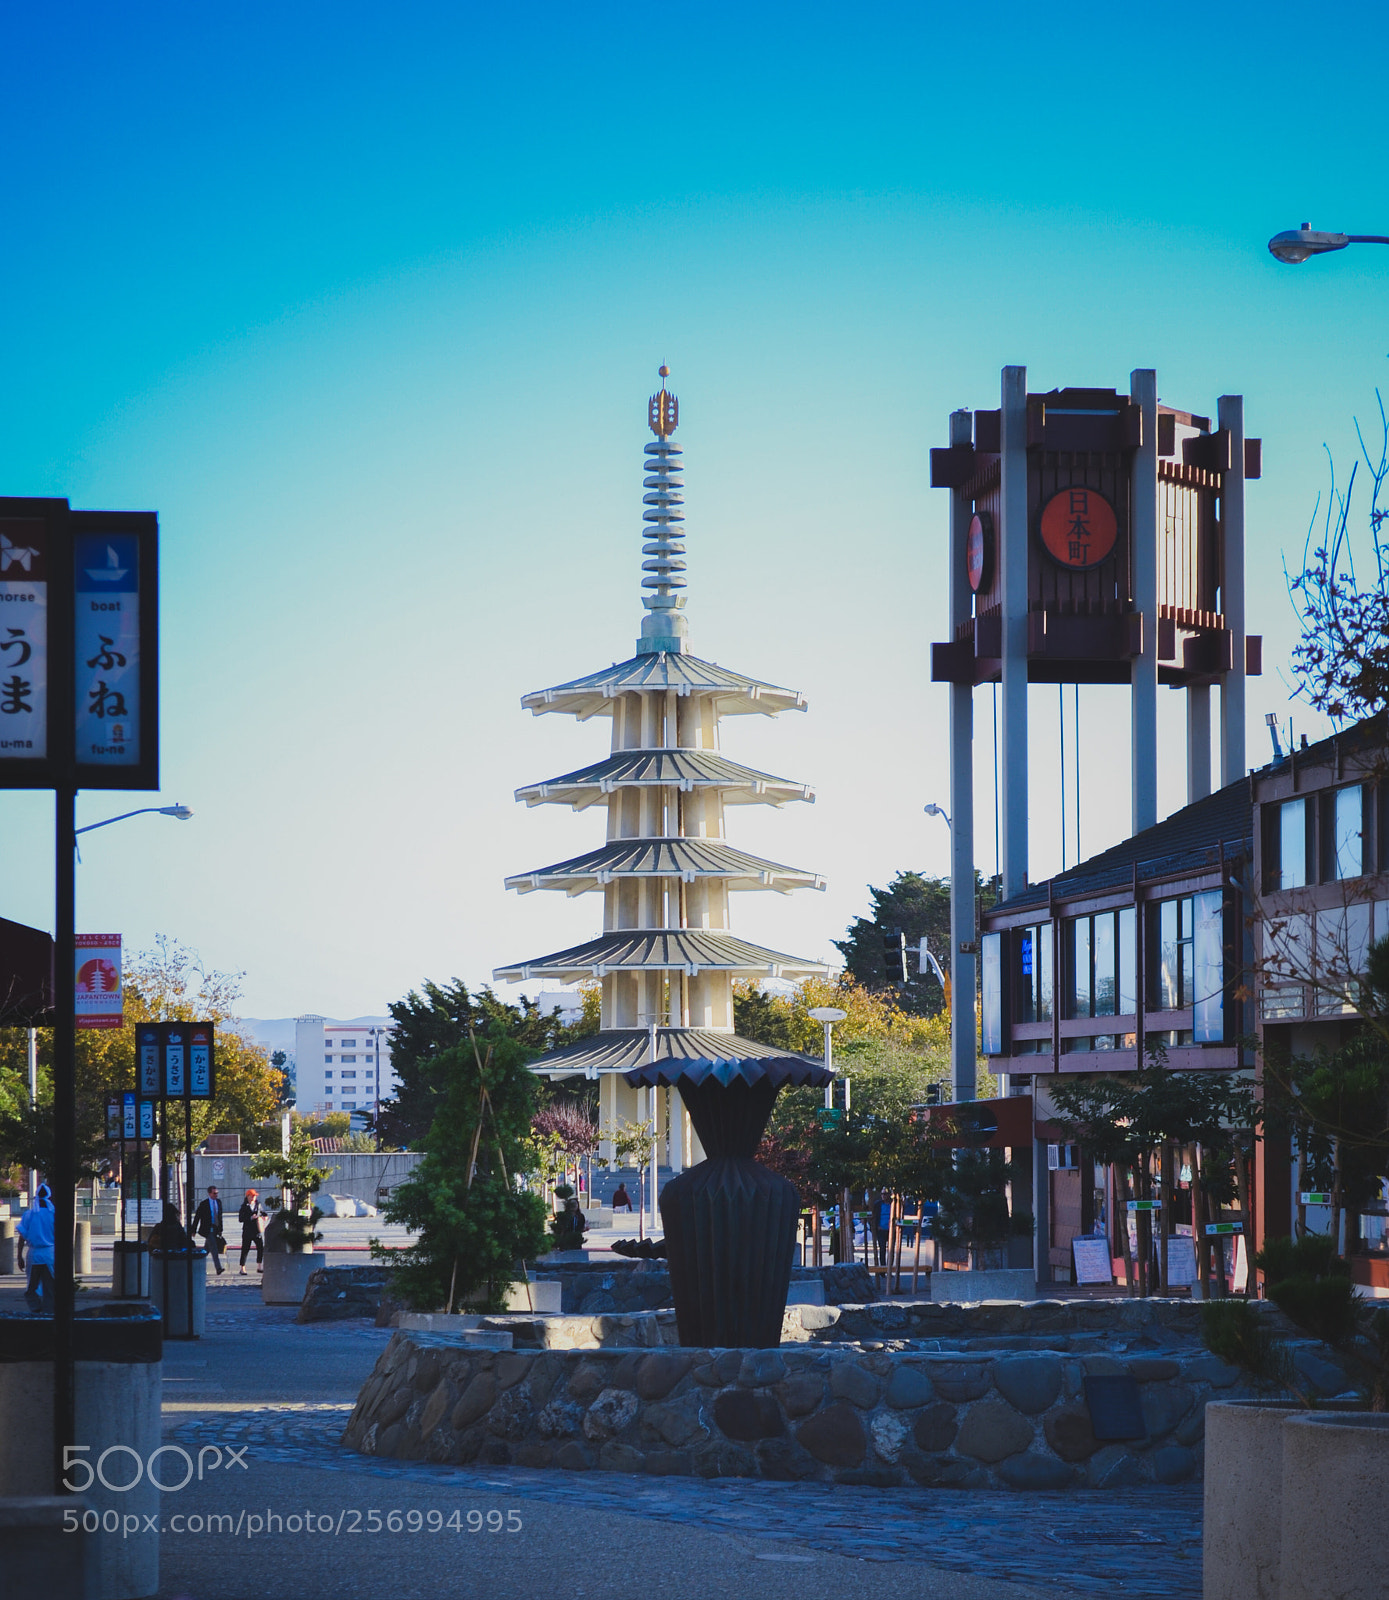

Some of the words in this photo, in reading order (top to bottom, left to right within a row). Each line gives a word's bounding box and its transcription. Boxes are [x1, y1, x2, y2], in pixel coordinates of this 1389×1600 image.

[1066, 491, 1091, 564] 日本町
[90, 600, 121, 611] boat
[0, 627, 33, 714] うま
[86, 633, 128, 719] ふね
